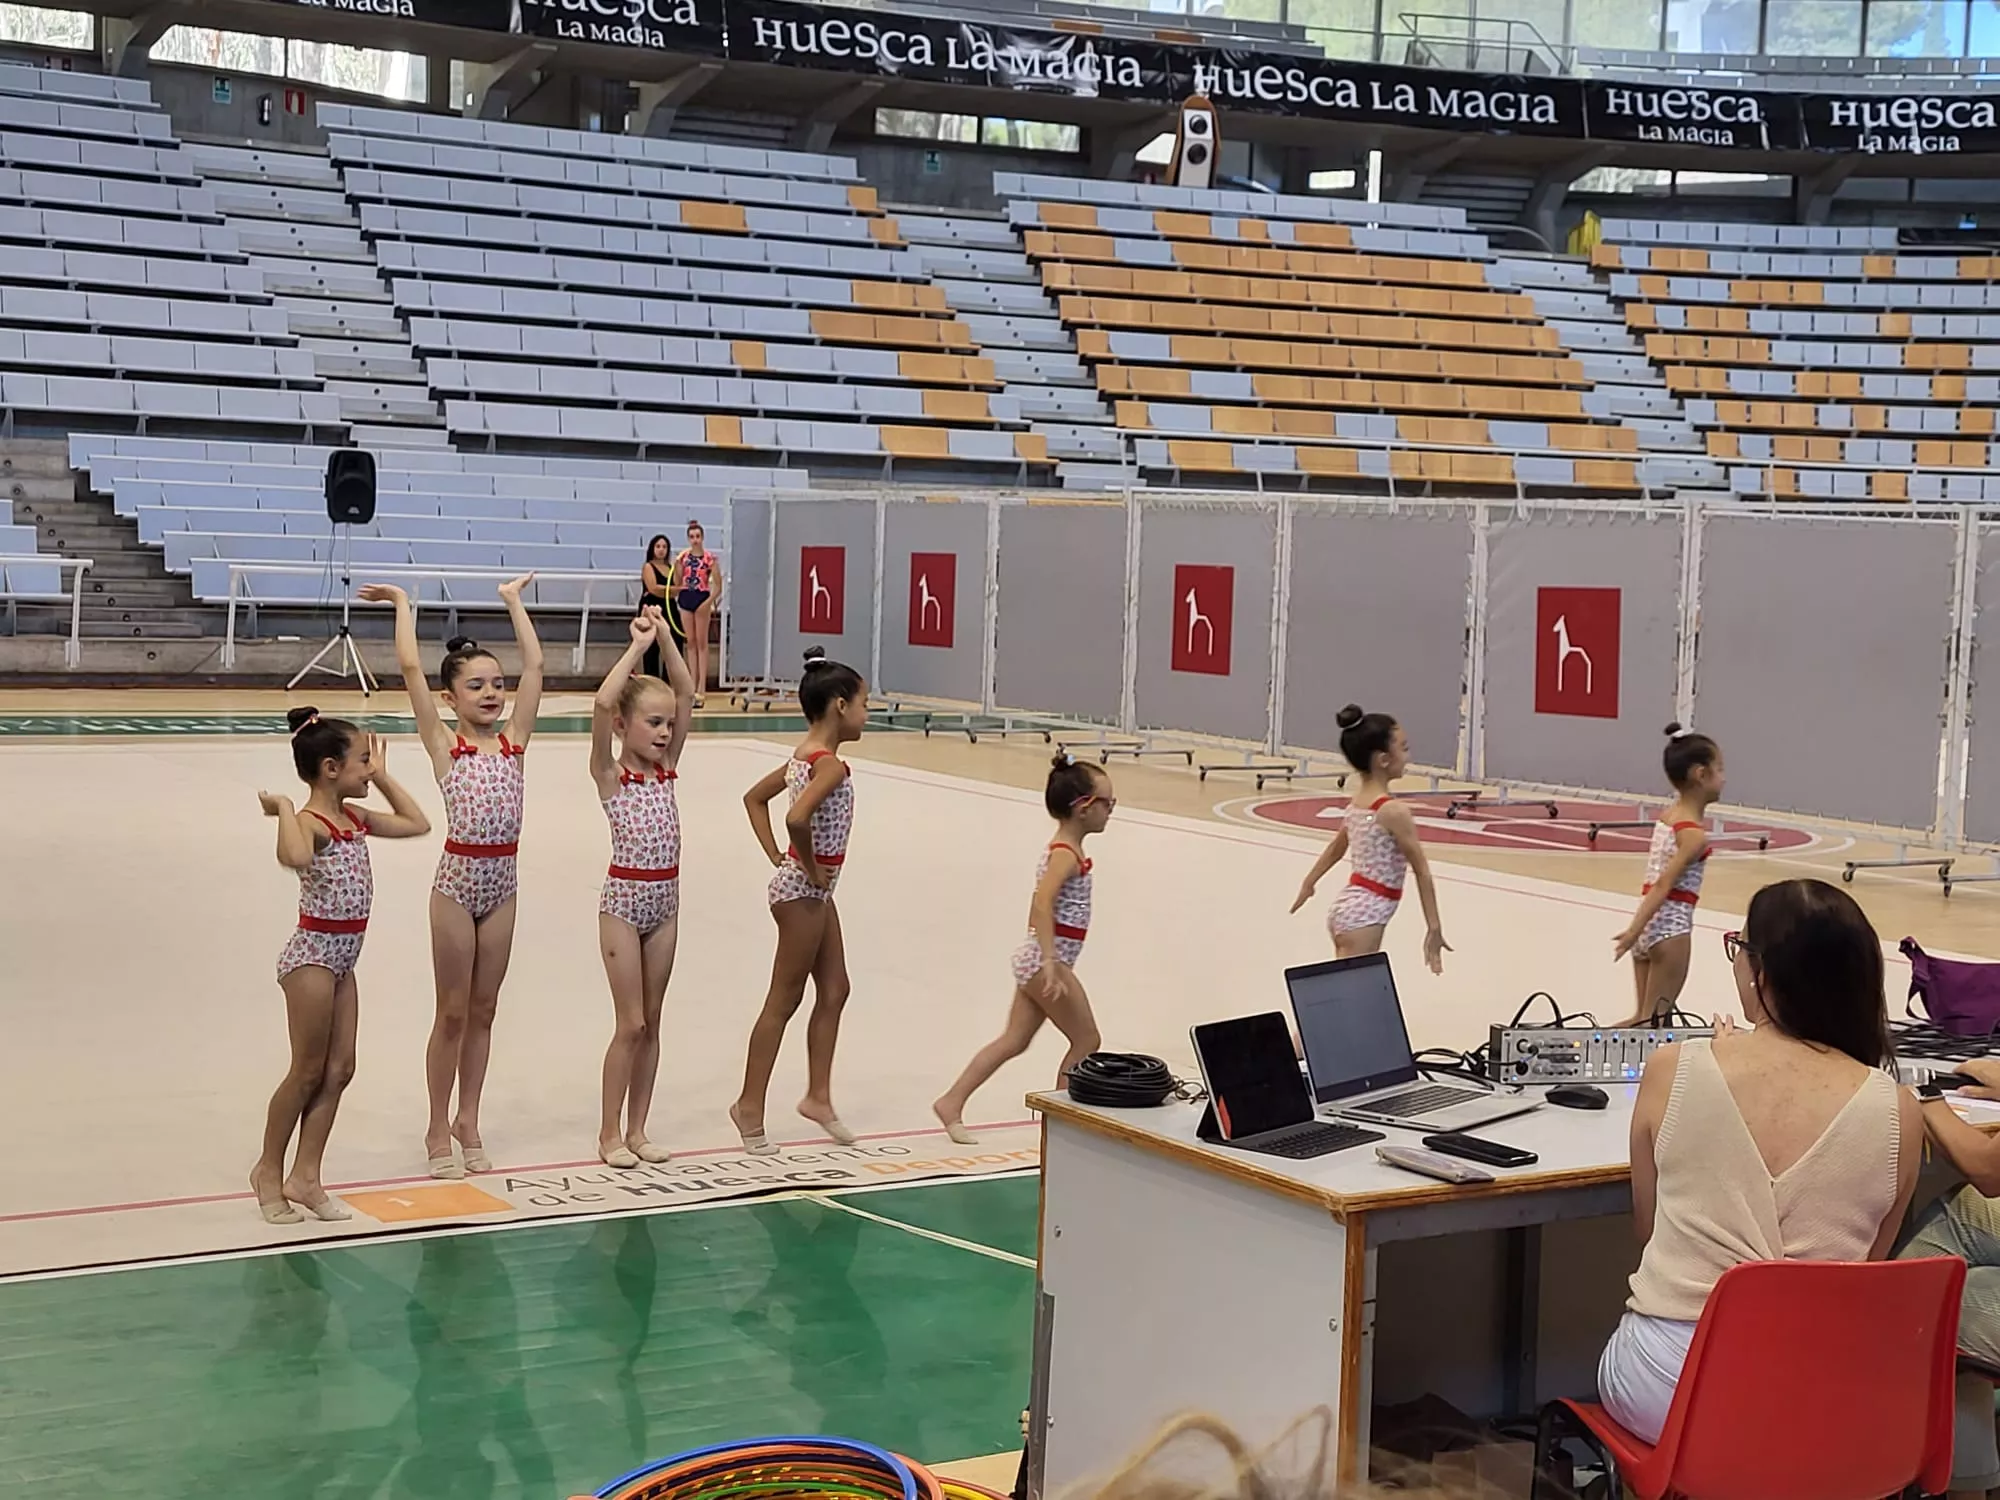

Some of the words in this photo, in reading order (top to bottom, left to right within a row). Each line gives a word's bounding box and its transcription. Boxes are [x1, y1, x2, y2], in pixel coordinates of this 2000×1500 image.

[556, 19, 585, 38] La
[752, 17, 935, 66] Huesca
[945, 37, 998, 71] La
[1193, 65, 1361, 108] Huesca
[1369, 81, 1419, 113] La
[1606, 88, 1761, 122] Huesca
[1829, 97, 1997, 129] Huesca
[1638, 124, 1663, 140] La
[1858, 134, 1883, 151] La
[505, 1146, 911, 1193] Ayuntamiento
[528, 1191, 605, 1207] de
[616, 1169, 857, 1197] Huesca
